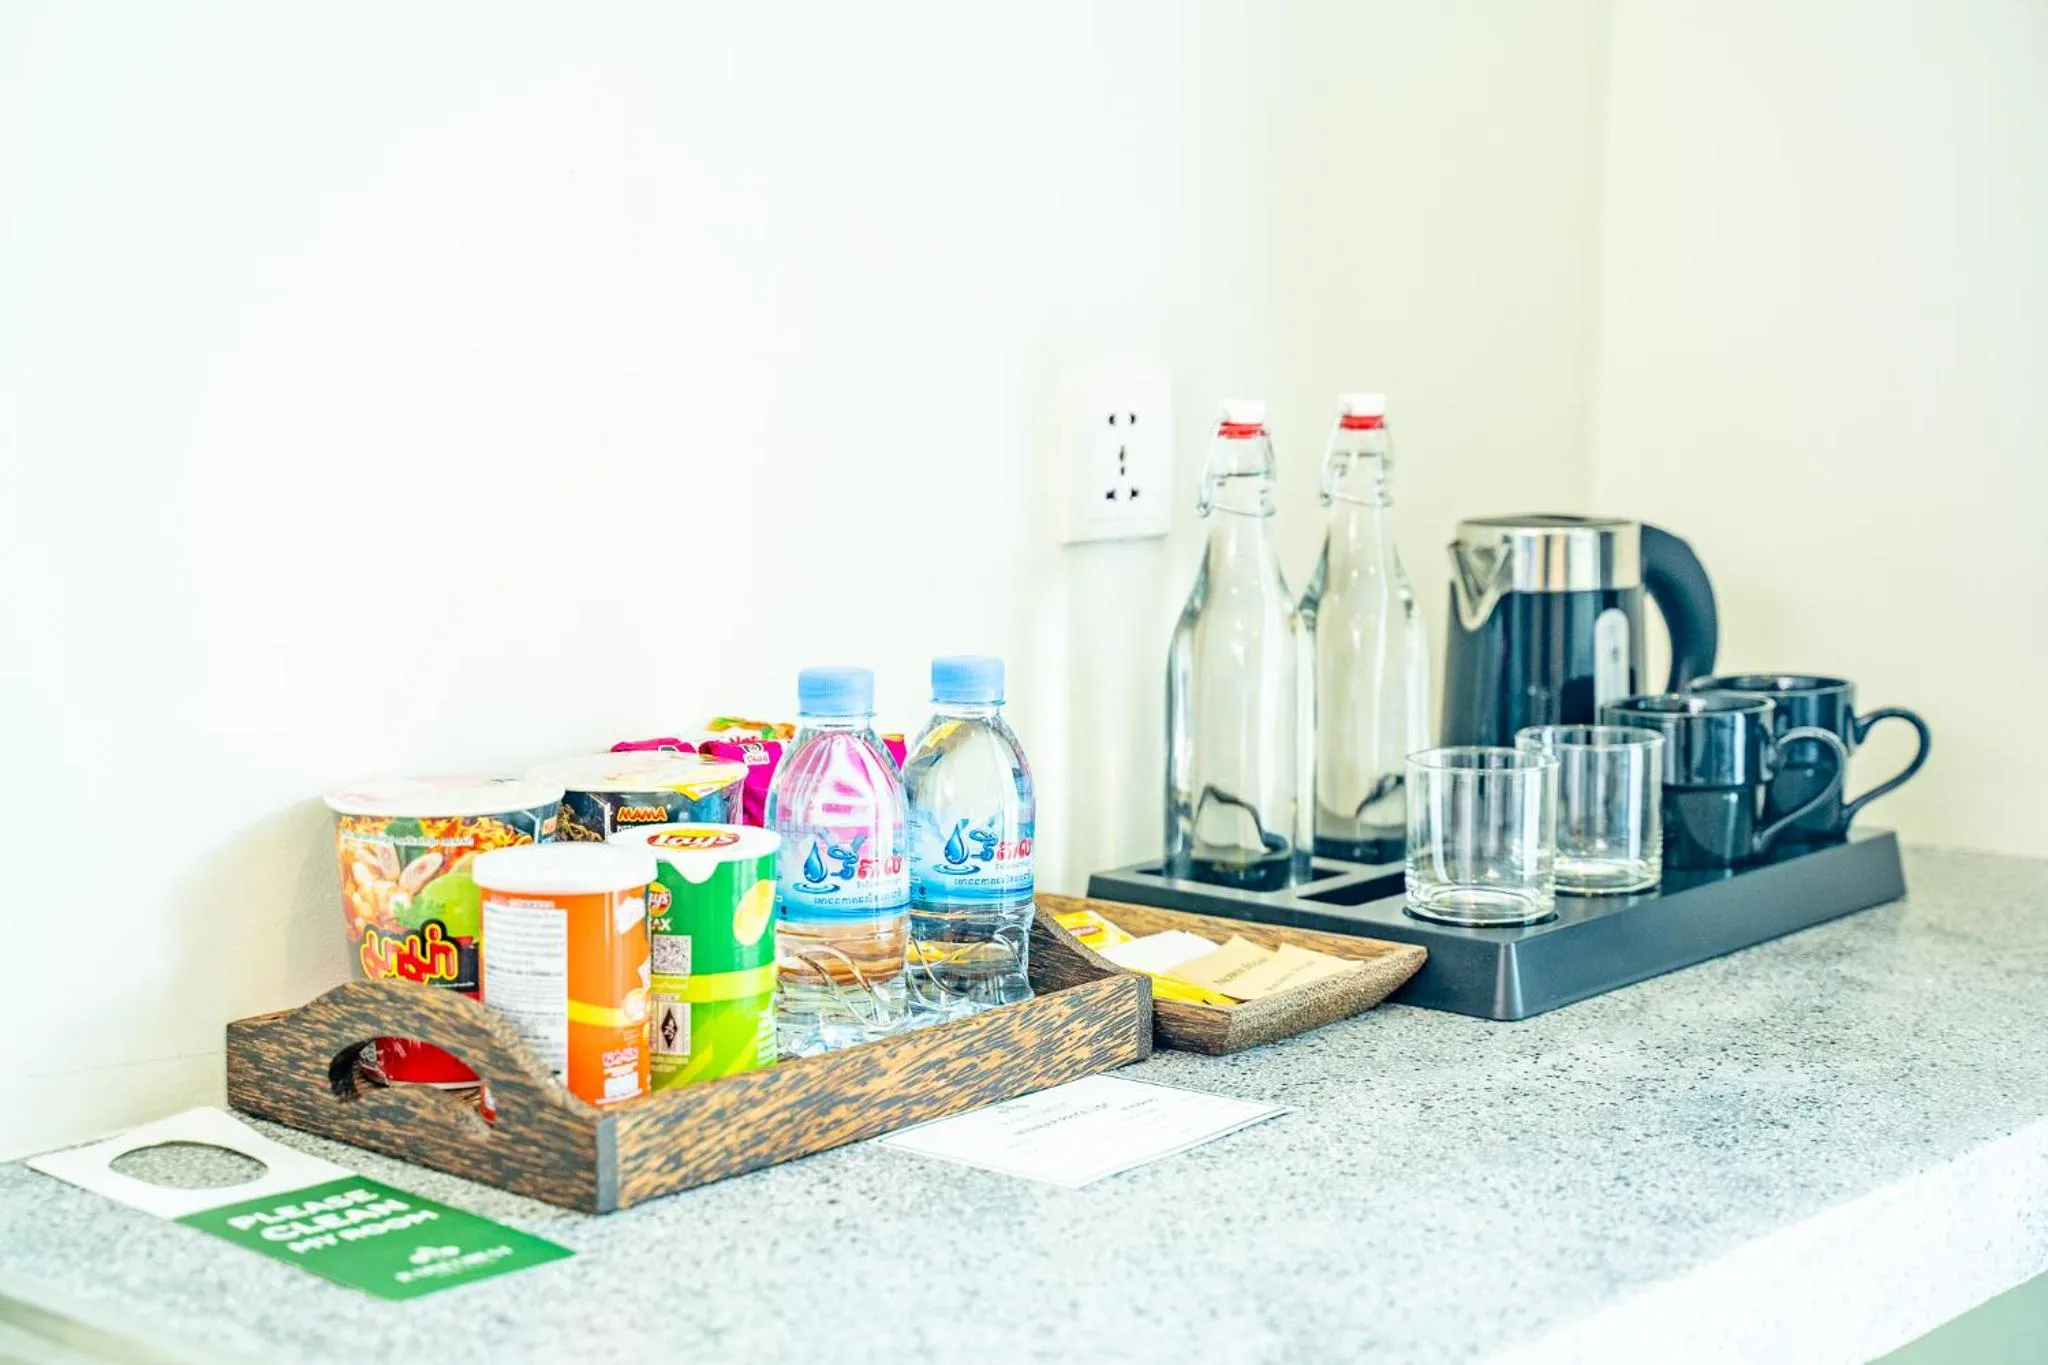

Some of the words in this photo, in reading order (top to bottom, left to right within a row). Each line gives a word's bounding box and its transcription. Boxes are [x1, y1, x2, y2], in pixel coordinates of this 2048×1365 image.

[616, 806, 668, 822] MAMA
[360, 922, 459, 984] มาม่า
[226, 1188, 379, 1231] PLEASE
[260, 1199, 411, 1242] CLEAN
[286, 1232, 339, 1254] MY
[336, 1209, 440, 1242] ROOM
